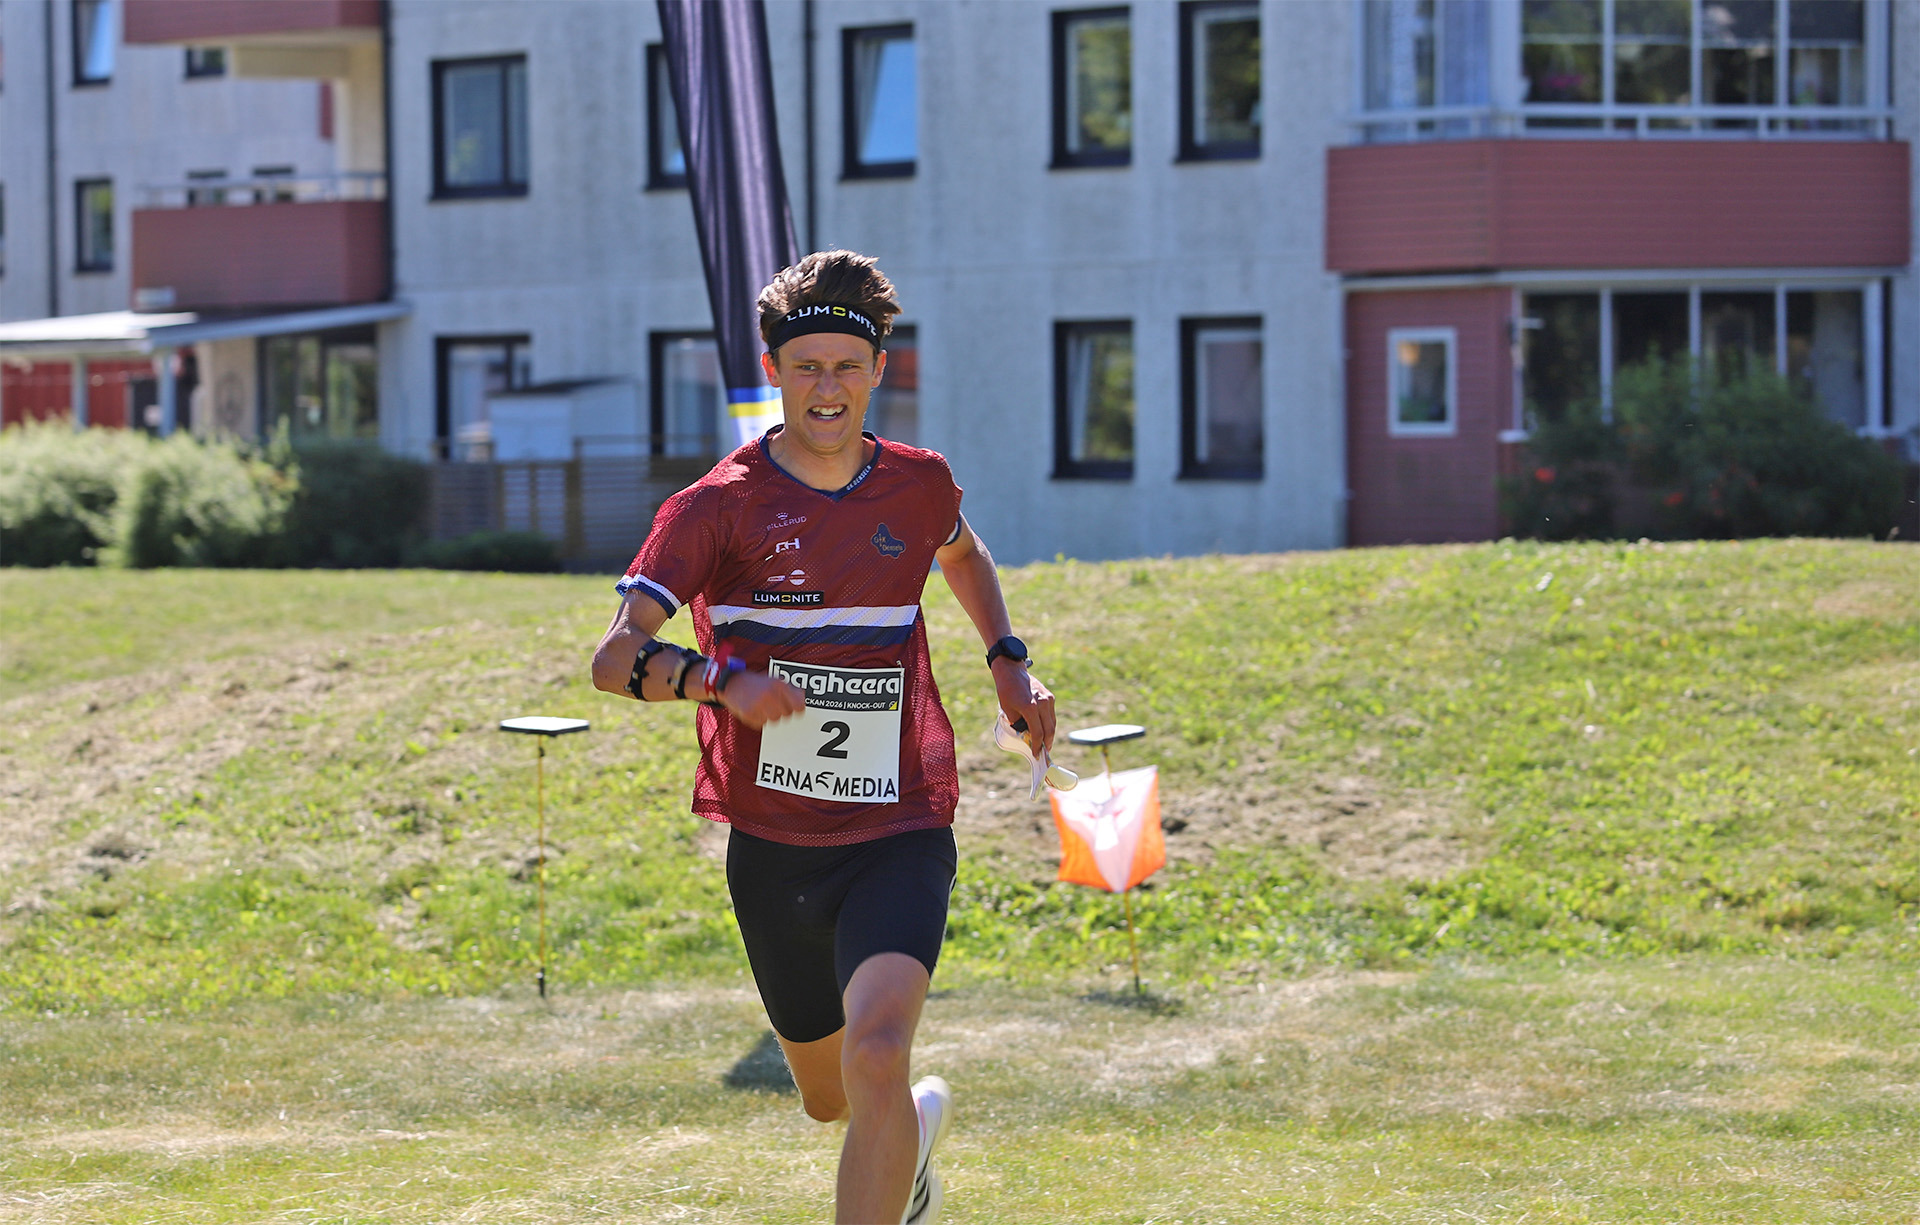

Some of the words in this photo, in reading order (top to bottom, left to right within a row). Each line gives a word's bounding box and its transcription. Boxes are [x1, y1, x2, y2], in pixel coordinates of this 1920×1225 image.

[786, 305, 877, 337] LUMONITE
[754, 593, 821, 603] LUMONITE
[773, 664, 900, 696] bagheera
[825, 700, 843, 709] 2026
[847, 702, 886, 710] KNOCK-OUT
[816, 720, 851, 760] 2
[760, 762, 813, 792] ERNA
[832, 776, 897, 798] MEDIA
